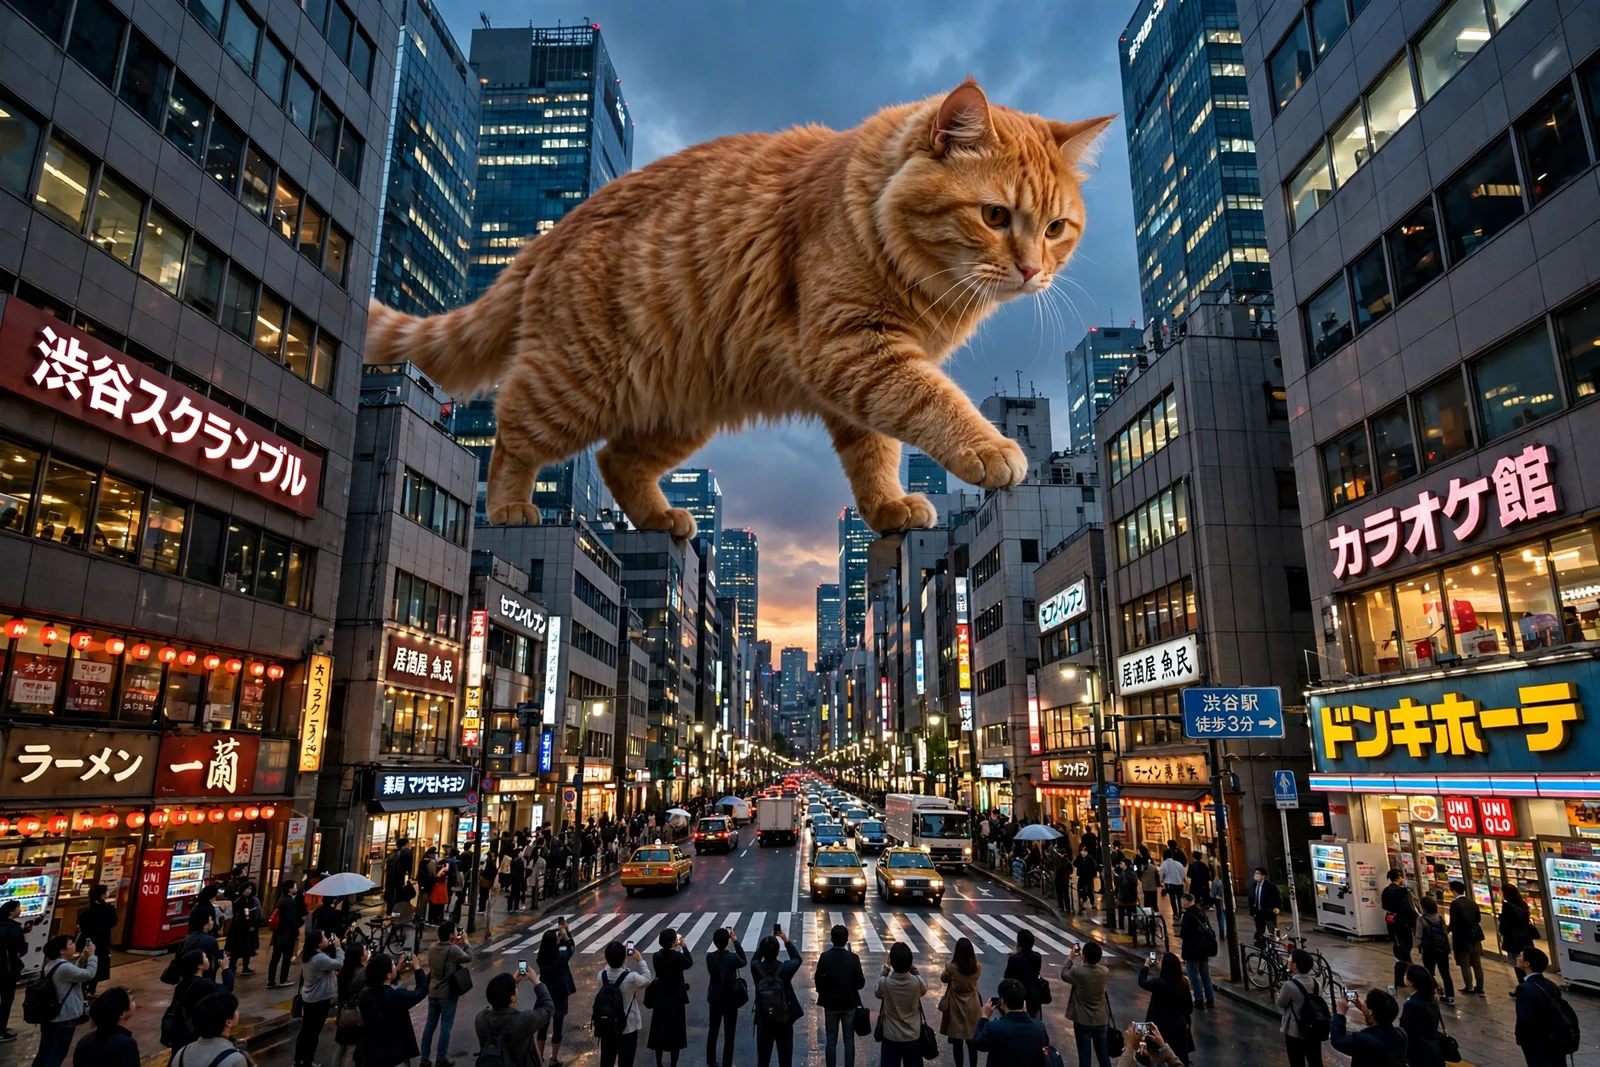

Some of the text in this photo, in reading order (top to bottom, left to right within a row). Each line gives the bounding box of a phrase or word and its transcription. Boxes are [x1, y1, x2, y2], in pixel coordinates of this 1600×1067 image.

[31, 325, 307, 496] 渋谷スクランブル
[1328, 444, 1557, 579] カラオケ館
[392, 646, 454, 684] 居酒屋 魚民
[1121, 645, 1193, 687] 居酒屋 魚民
[1203, 693, 1259, 712] 渋谷駅
[1195, 715, 1255, 733] 徒歩3分
[1320, 682, 1584, 759] ドンキホーテ
[18, 744, 143, 783] ラーメン
[383, 775, 465, 794] 薬局 マツモトキヨシ
[1447, 800, 1469, 814] UNI
[1482, 802, 1506, 816] UNI
[1449, 815, 1473, 831] QLO
[1485, 818, 1511, 833] QLO
[143, 872, 160, 883] UNI
[142, 884, 160, 896] QLO
